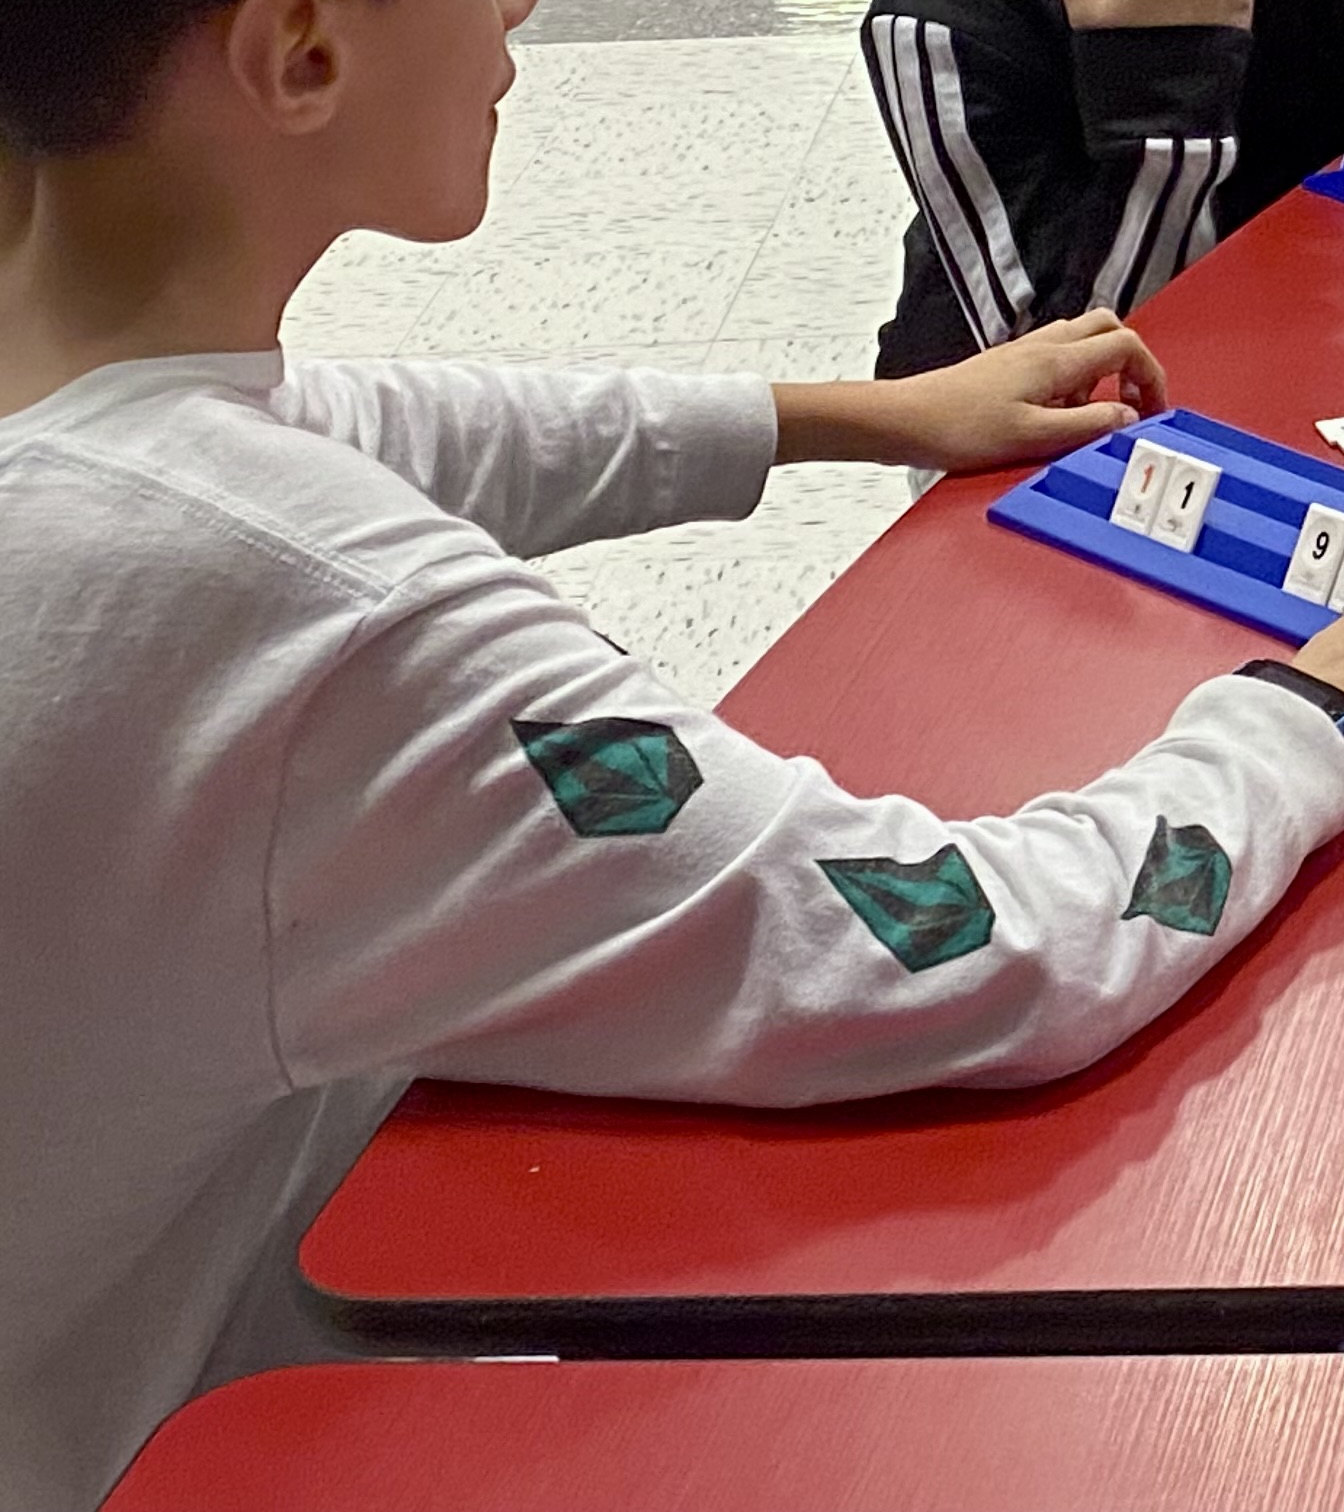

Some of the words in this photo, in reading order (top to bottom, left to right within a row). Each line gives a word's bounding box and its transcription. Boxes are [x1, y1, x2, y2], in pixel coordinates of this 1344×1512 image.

[1141, 464, 1155, 494] 1
[1181, 481, 1195, 509] 1
[1312, 531, 1330, 560] 9
